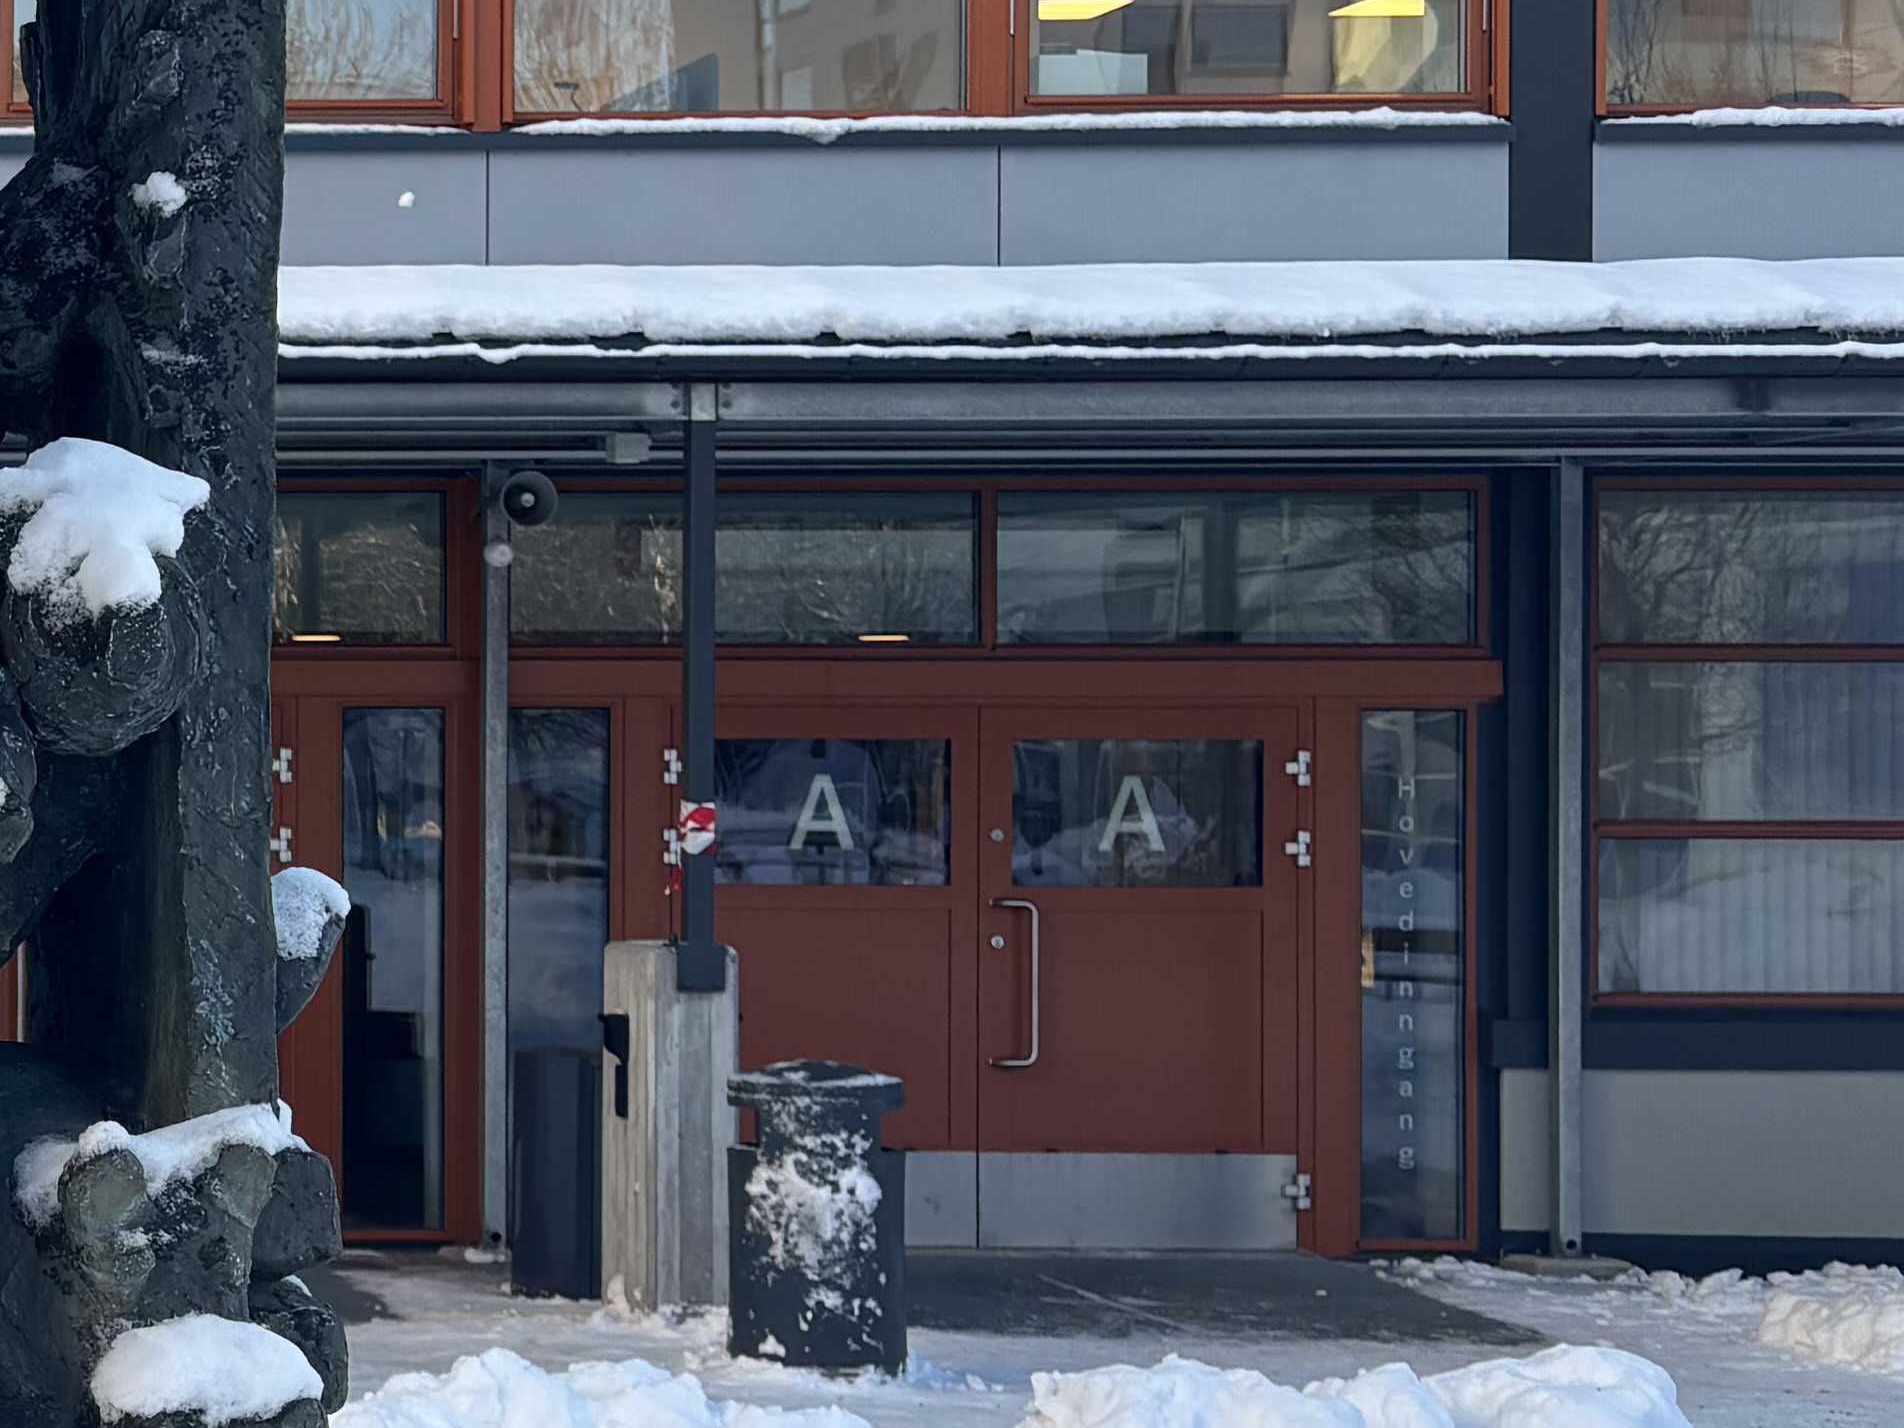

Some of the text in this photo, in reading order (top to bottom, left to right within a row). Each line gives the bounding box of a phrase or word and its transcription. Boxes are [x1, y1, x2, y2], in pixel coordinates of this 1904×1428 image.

[788, 773, 856, 851] A
[1098, 775, 1166, 853] A
[1398, 778, 1416, 1170] Hovedinngang
